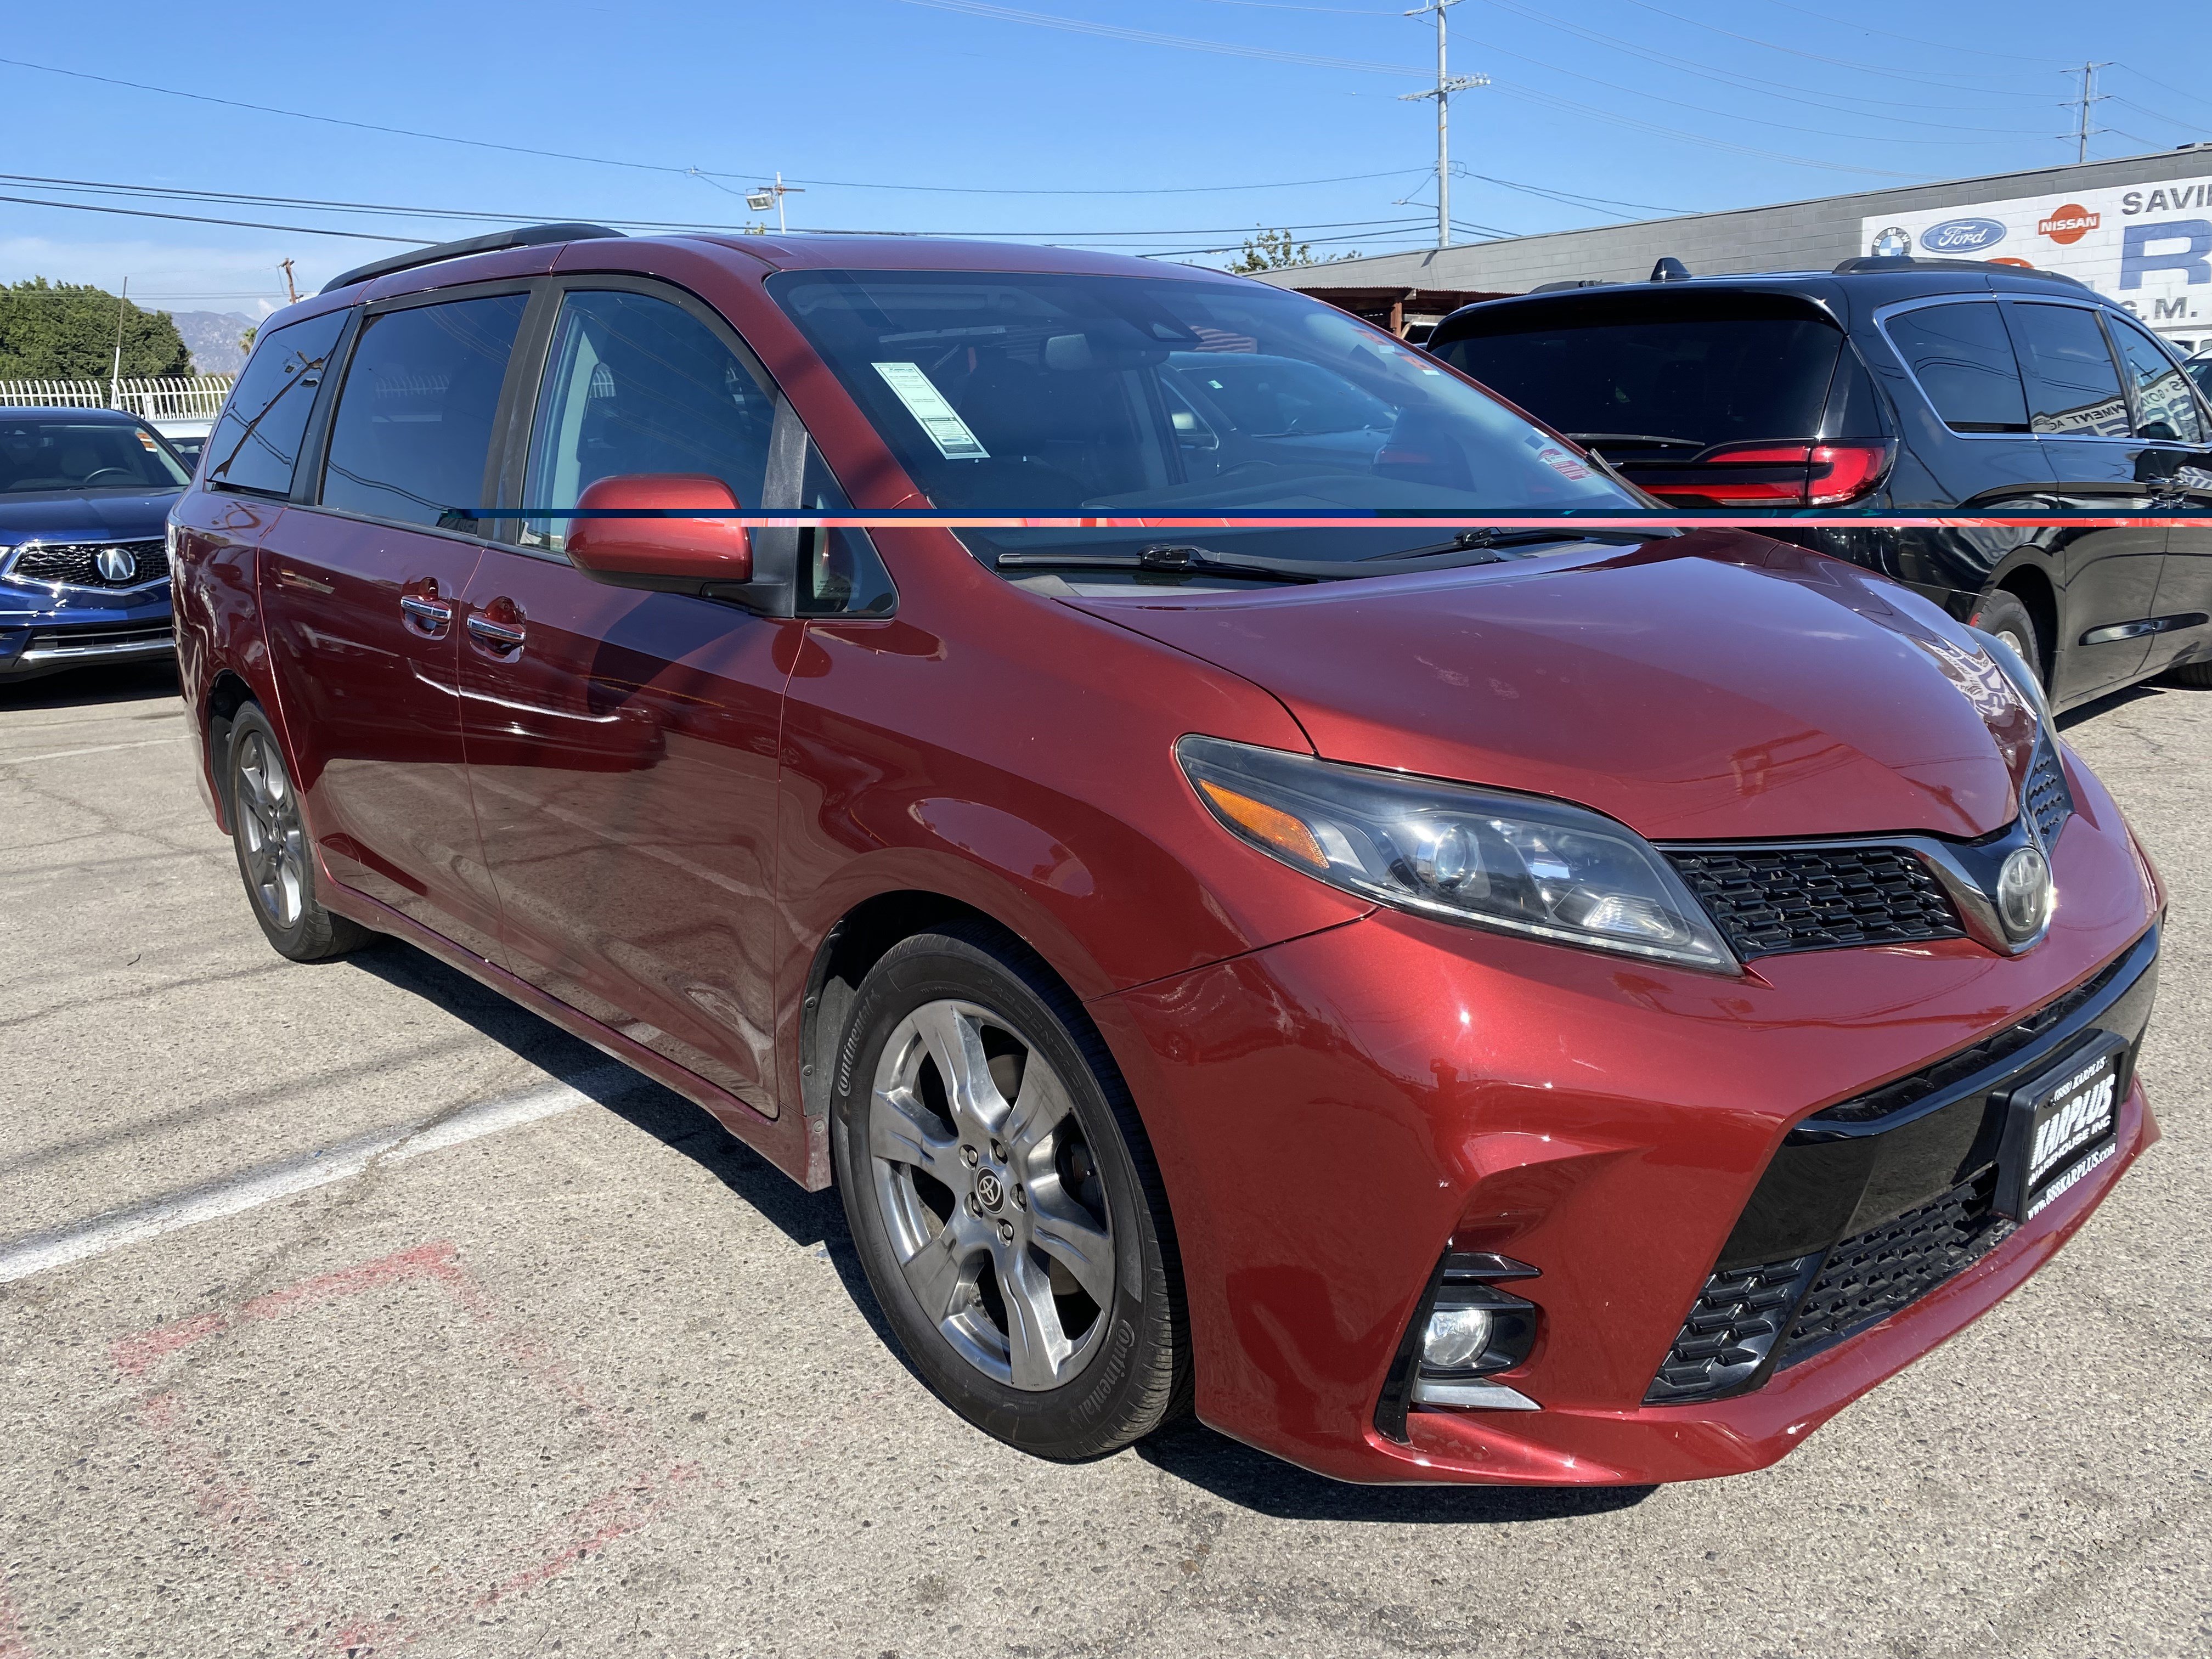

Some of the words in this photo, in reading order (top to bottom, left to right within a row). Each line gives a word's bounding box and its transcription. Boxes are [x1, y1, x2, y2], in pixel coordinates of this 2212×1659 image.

[1874, 227, 1912, 248] BMW
[1938, 225, 1988, 247] Ford
[2041, 216, 2098, 233] NISSAN
[838, 996, 873, 1097] Continental
[2072, 1056, 2107, 1090] KARPLUS
[2030, 1074, 2116, 1170] KARPLUS
[2028, 1128, 2090, 1186] WAREHOUSE
[2091, 1115, 2111, 1135] INC
[1079, 1319, 1135, 1424] Continental
